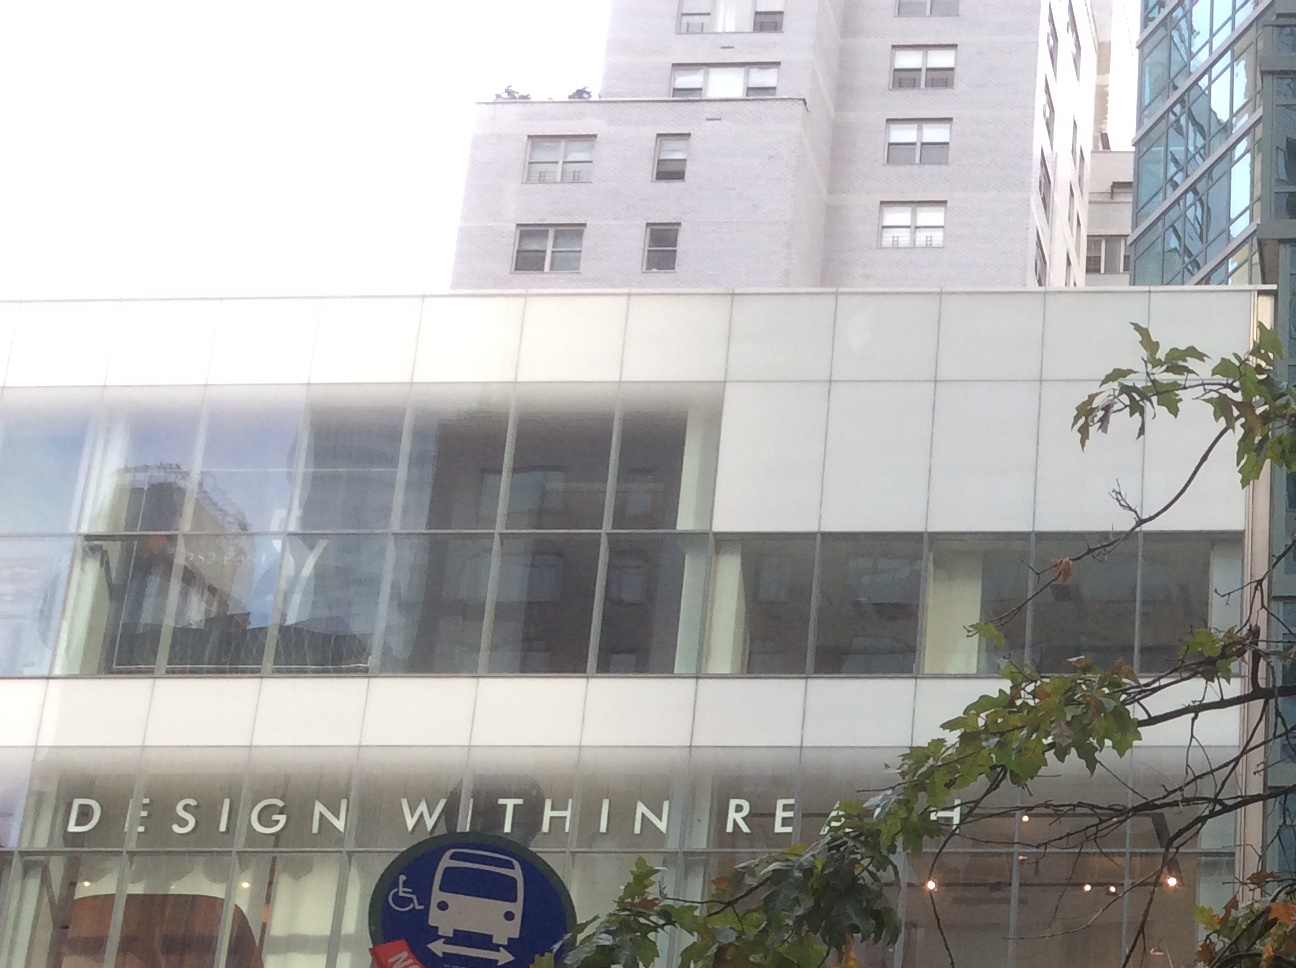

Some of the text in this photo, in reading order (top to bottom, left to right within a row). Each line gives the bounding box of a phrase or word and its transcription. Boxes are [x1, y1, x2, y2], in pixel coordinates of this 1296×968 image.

[67, 798, 961, 835] DESIGN WITHIN REAH
